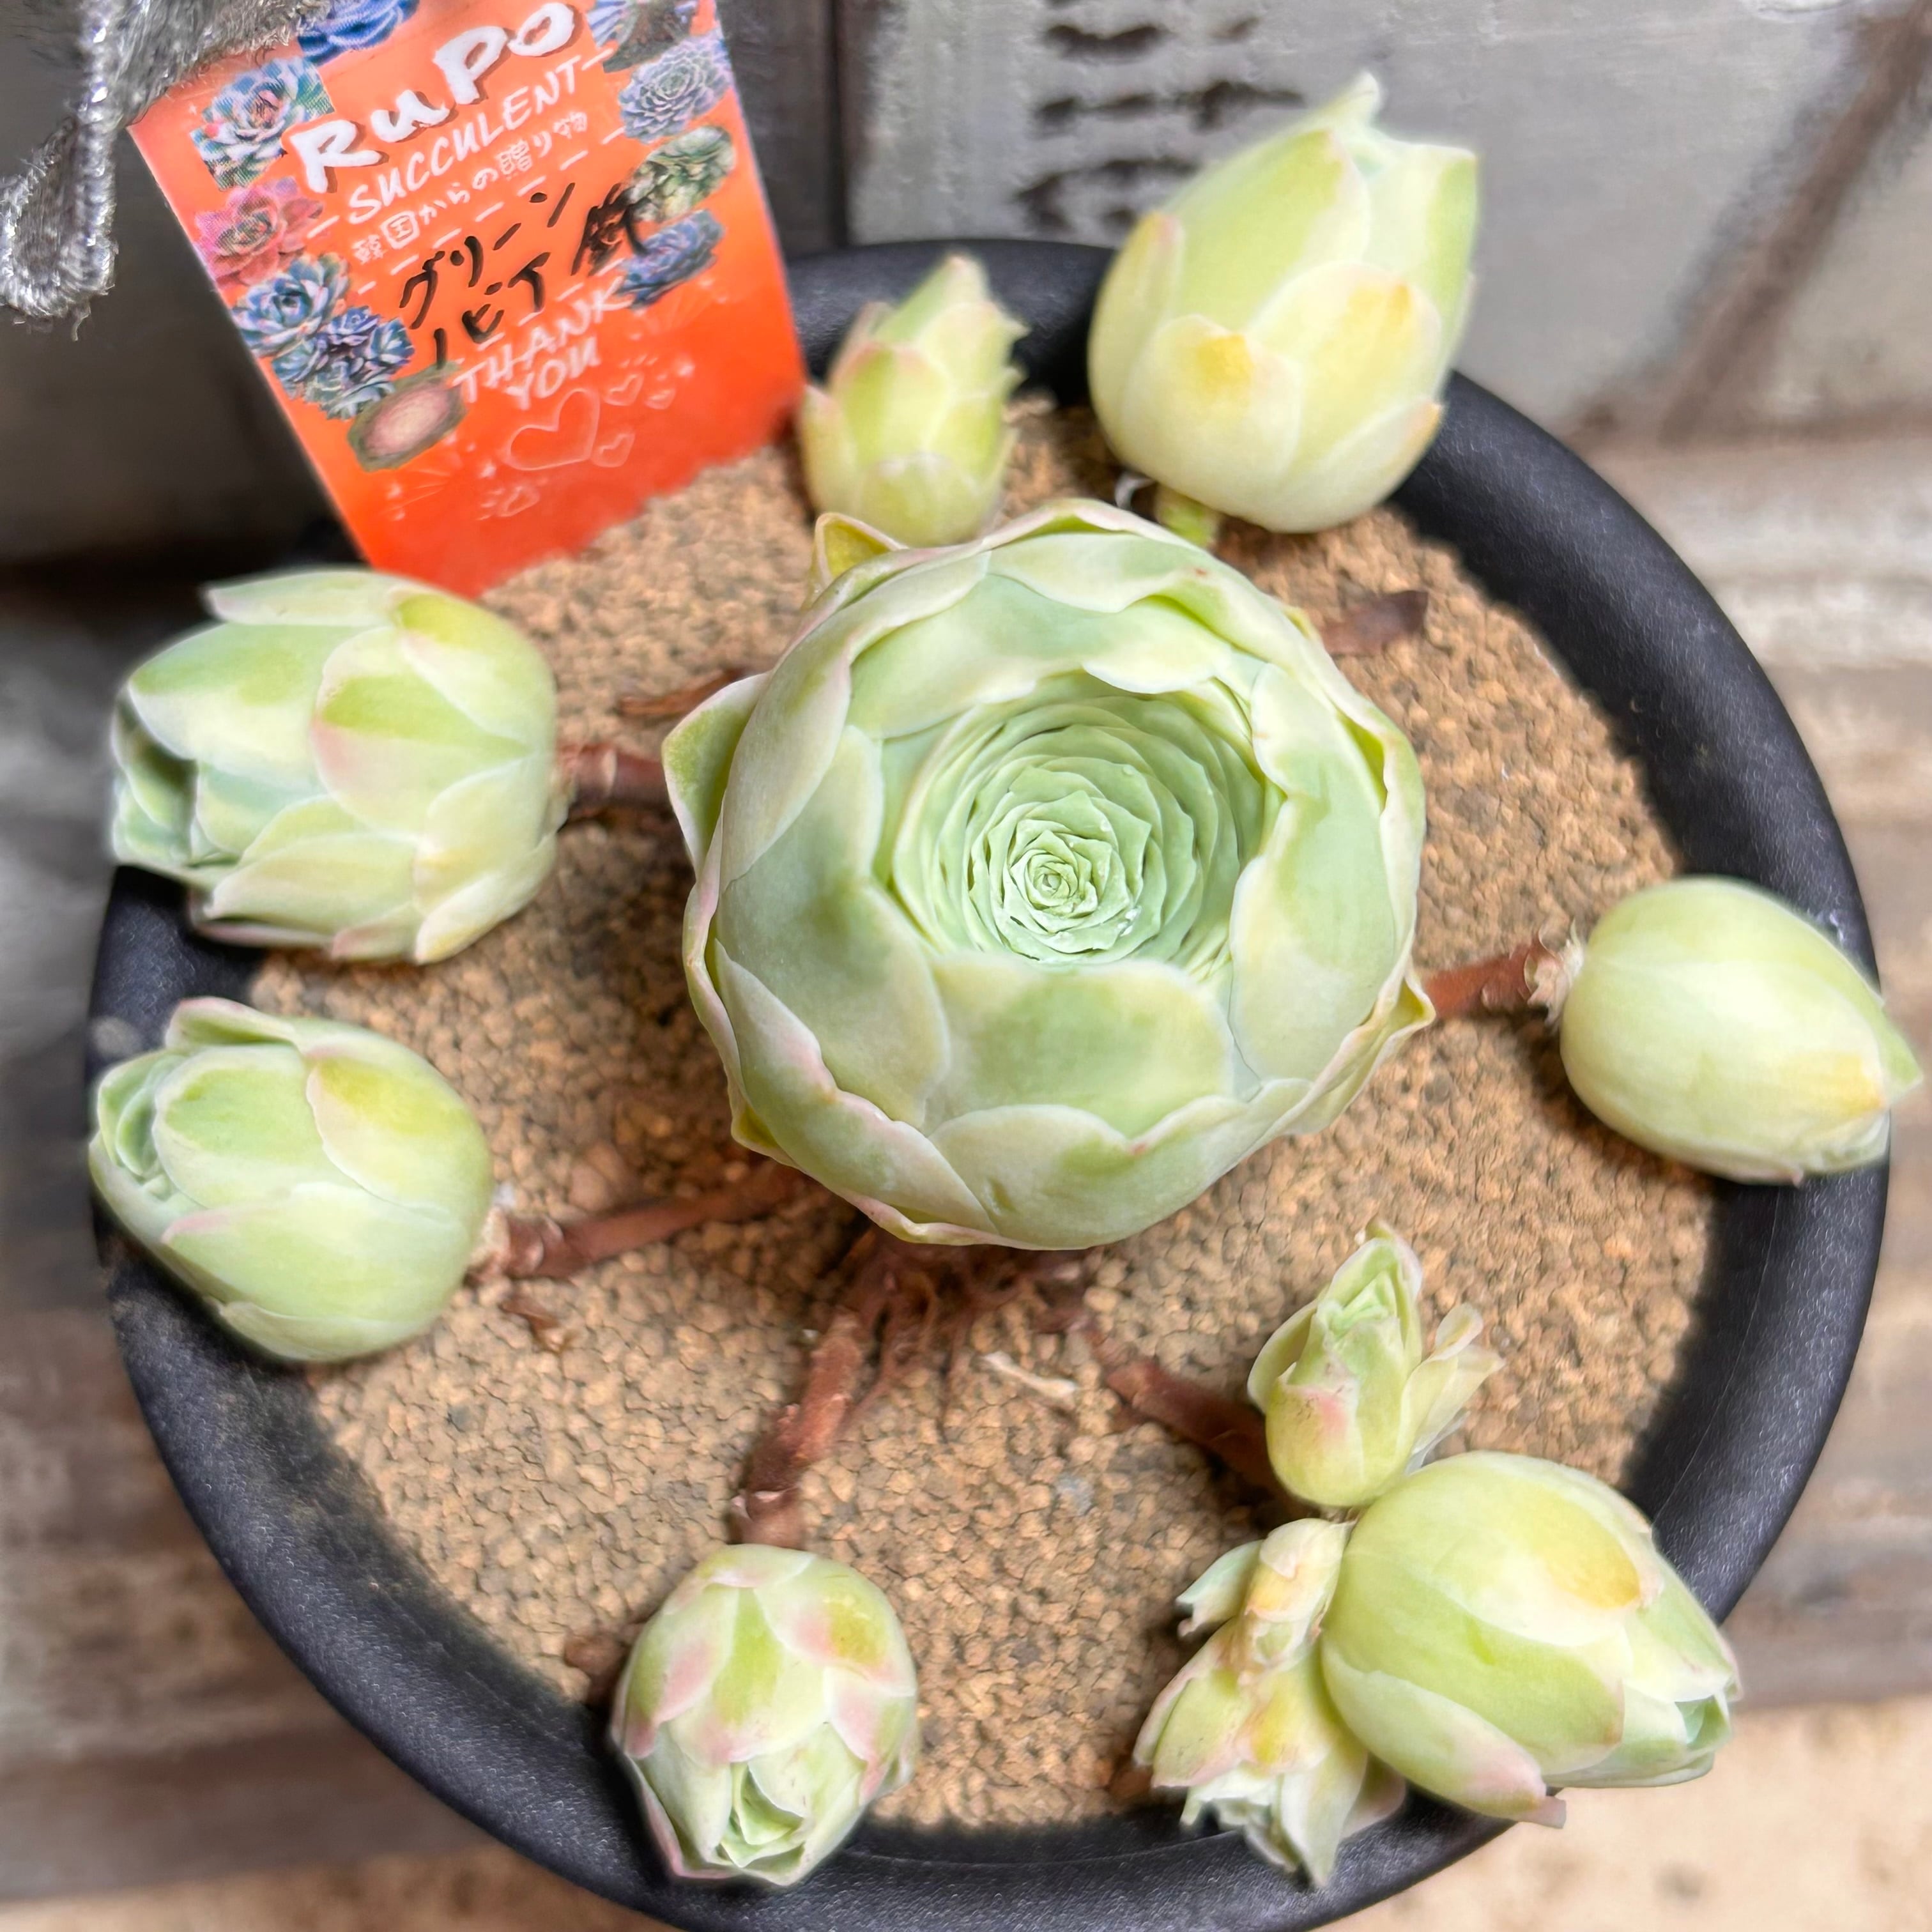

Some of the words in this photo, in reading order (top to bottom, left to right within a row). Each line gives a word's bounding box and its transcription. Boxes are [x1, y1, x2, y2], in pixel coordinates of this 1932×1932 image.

[349, 56, 582, 224] SUCCULENT
[353, 111, 587, 264] 韓国からの贈り物
[399, 183, 575, 330] グリーン
[452, 275, 632, 404] THANK
[503, 337, 601, 410] YOU
